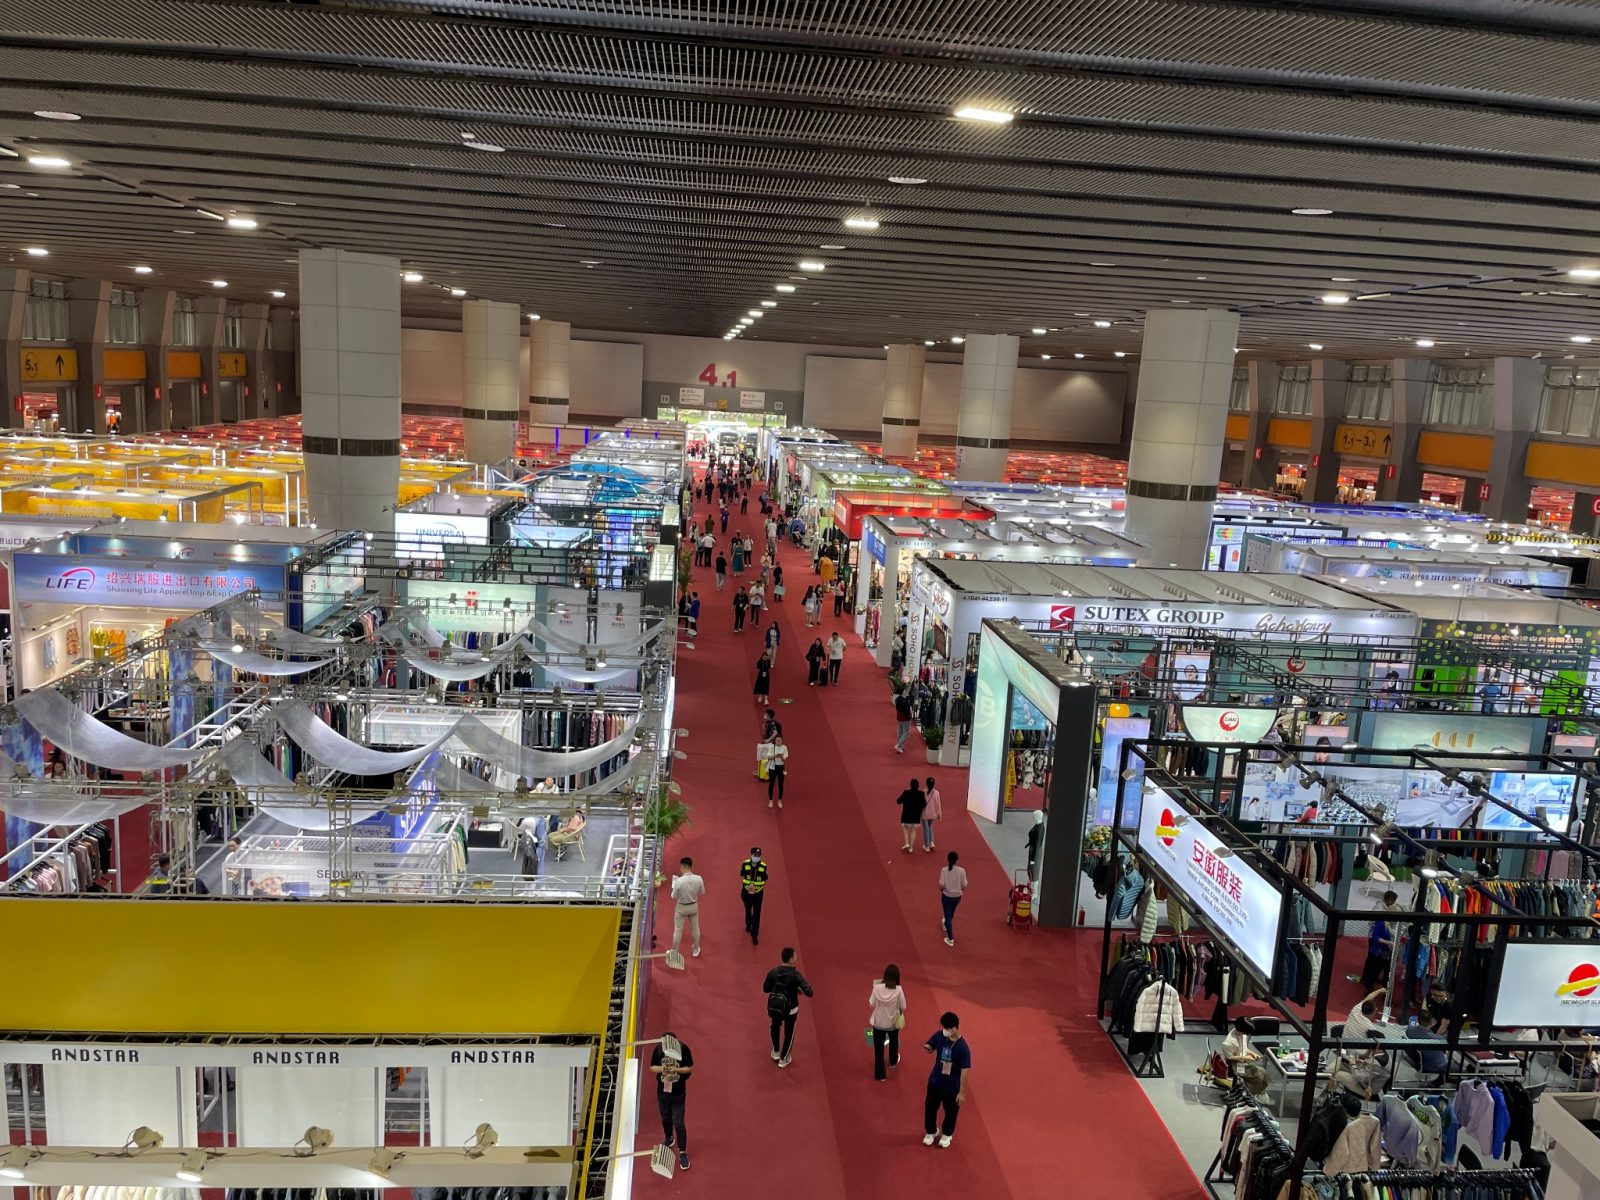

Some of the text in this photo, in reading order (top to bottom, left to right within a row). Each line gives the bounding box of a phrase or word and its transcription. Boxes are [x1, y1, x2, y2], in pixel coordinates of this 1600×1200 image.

[25, 359, 38, 371] 5.1
[699, 363, 737, 388] 4.1
[1255, 448, 1262, 459] K
[1313, 457, 1319, 466] J
[1480, 486, 1489, 499] H
[416, 528, 465, 538] UNIVERSAL
[46, 577, 90, 590] LIFE
[106, 571, 256, 590] 绍兴瑞服进出口有限公司
[159, 587, 188, 596] Apparel
[1085, 606, 1225, 625] SUTEX GROUP
[910, 628, 918, 654] SOHO
[1193, 839, 1243, 903] 安徽服装
[51, 1048, 139, 1063] ANDSTAR
[253, 1051, 340, 1065] ANDSTAR
[451, 1050, 535, 1064] ANDSTAR
